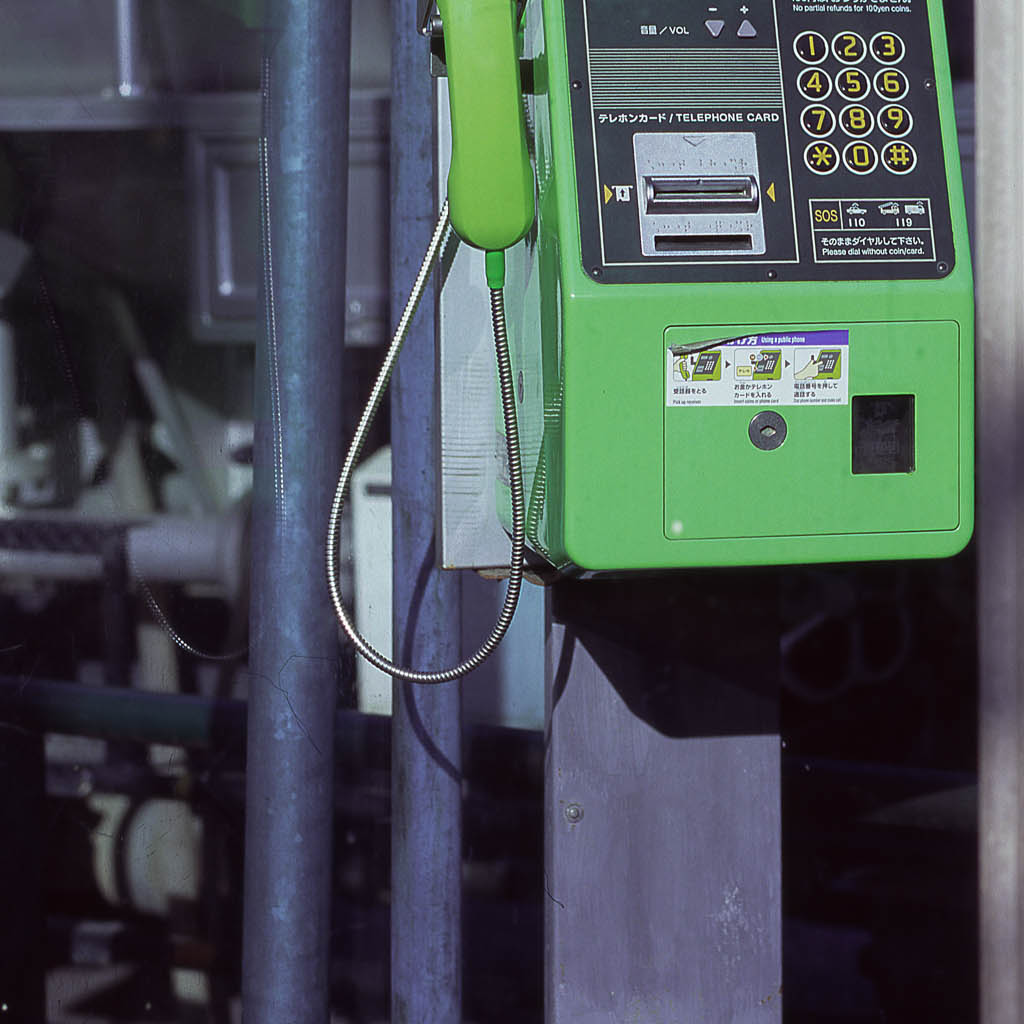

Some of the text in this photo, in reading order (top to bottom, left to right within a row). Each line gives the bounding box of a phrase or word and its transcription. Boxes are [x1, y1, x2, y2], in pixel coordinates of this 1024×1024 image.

[793, 4, 912, 14] No partial refunds for 100yen coins.
[808, 35, 896, 56] 1 2 3
[806, 71, 900, 93] 4 5 6
[598, 113, 667, 123] テレホンカード
[675, 112, 744, 123] TELEPHONE
[746, 112, 780, 122] CARD
[811, 107, 903, 131] 7 8 9
[852, 145, 870, 166] 0
[814, 209, 838, 223] SOS
[848, 217, 913, 227] 110 119
[821, 236, 924, 246] そのままダイヤルして下さい。
[847, 247, 861, 255] dial
[861, 247, 888, 255] without
[889, 246, 925, 255] coin/card.
